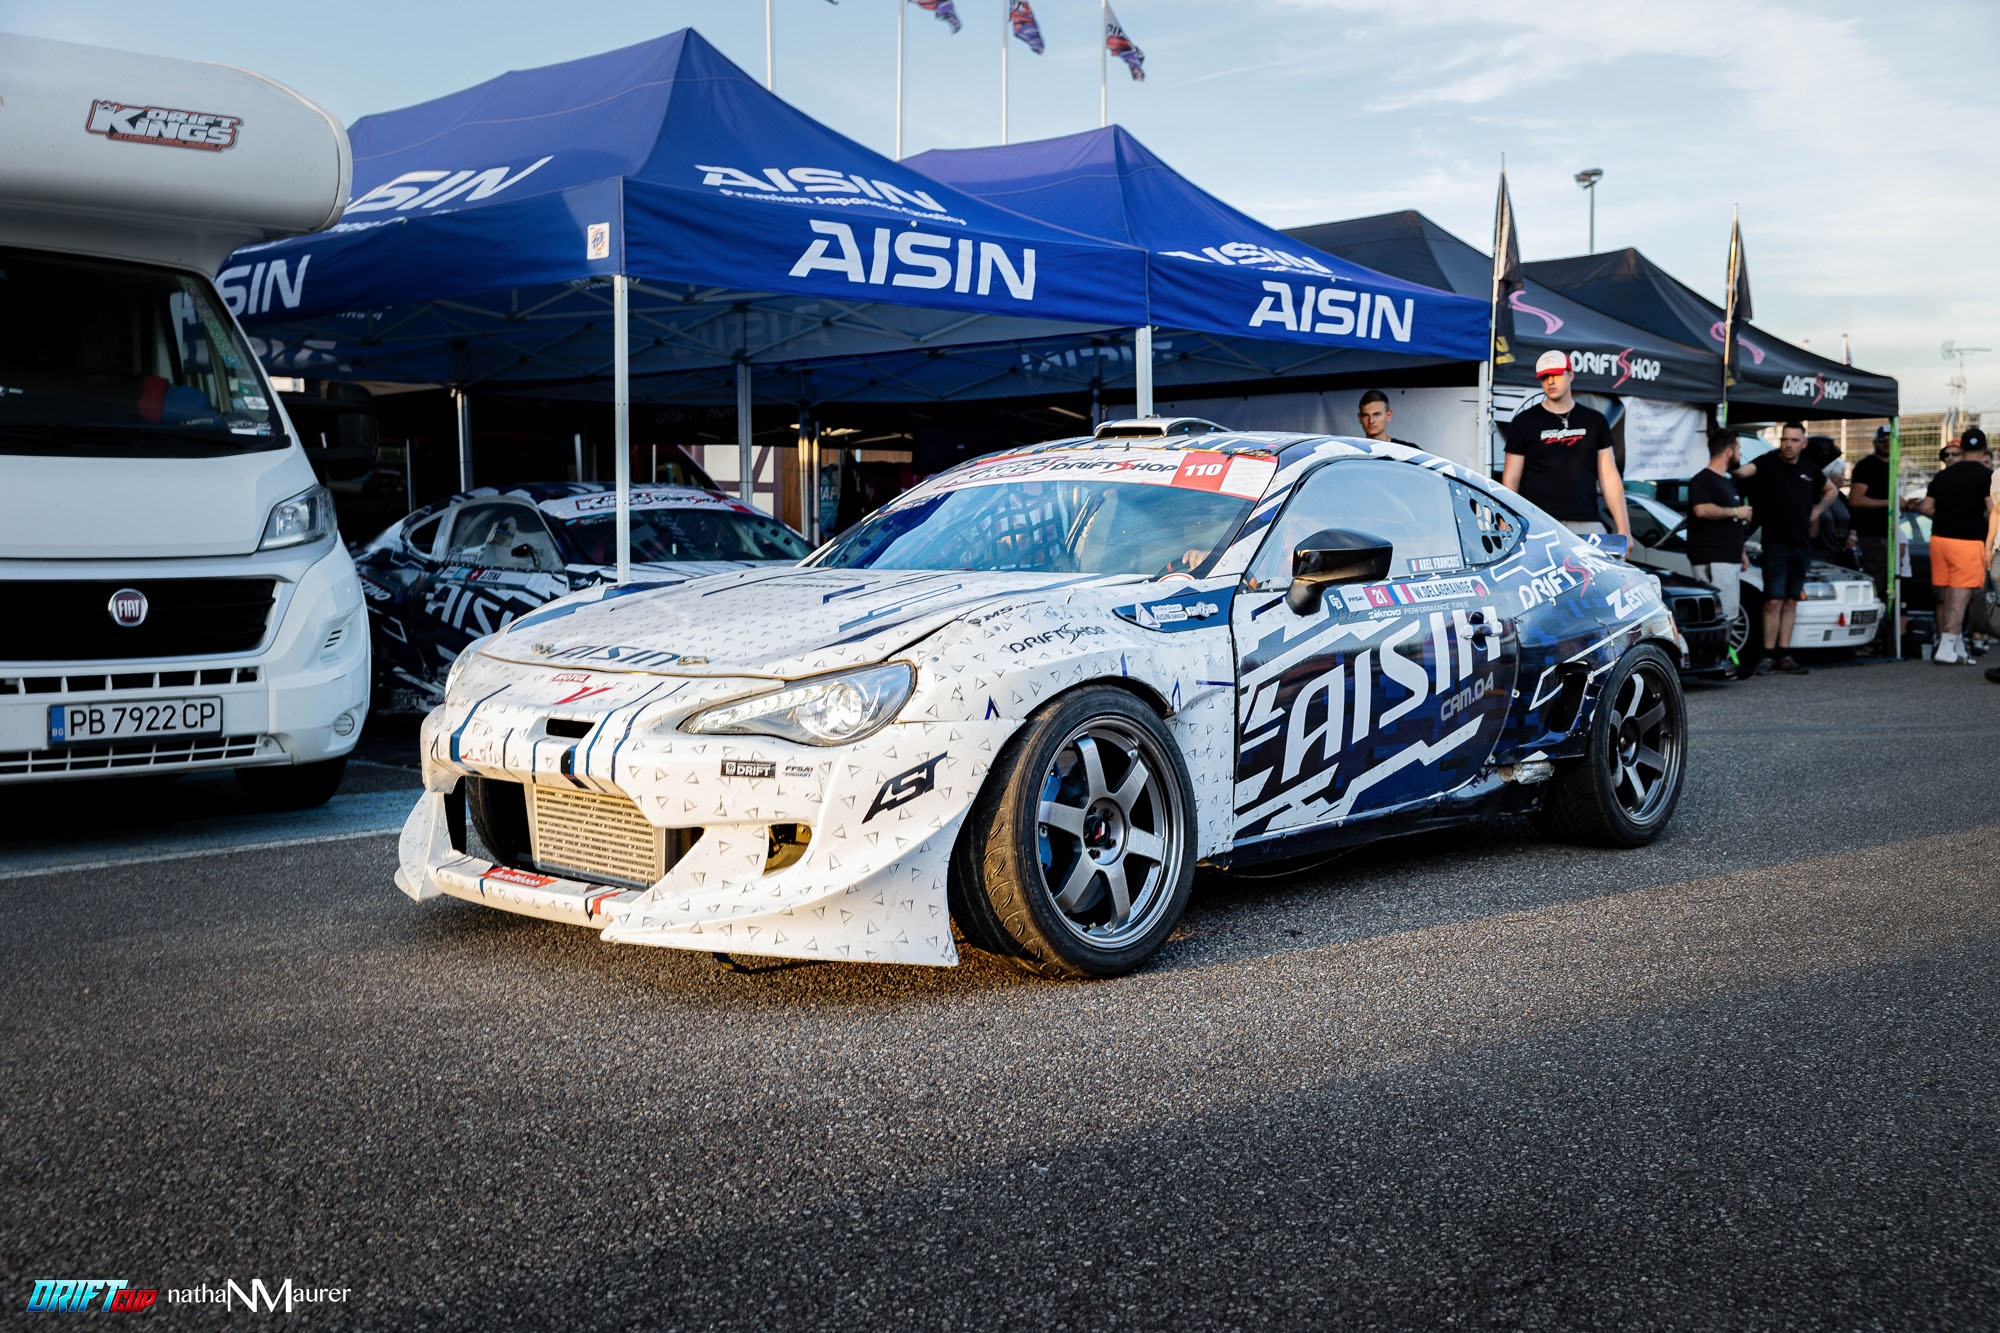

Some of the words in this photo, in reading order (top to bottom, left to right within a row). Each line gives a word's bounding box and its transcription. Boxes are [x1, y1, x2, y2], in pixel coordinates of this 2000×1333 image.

[144, 109, 238, 128] DRIFT
[344, 155, 554, 216] SIN
[694, 164, 948, 213] AISIN
[788, 219, 1037, 301] AISIN
[1248, 280, 1415, 343] AISIN
[1184, 463, 1223, 476] 110
[117, 600, 141, 618] FIAT
[1372, 588, 1388, 604] 21
[1282, 606, 1502, 784] AISIN
[69, 708, 106, 736] PB
[112, 704, 178, 735] 7922
[182, 702, 216, 729] CP
[736, 765, 771, 777] DRIFT
